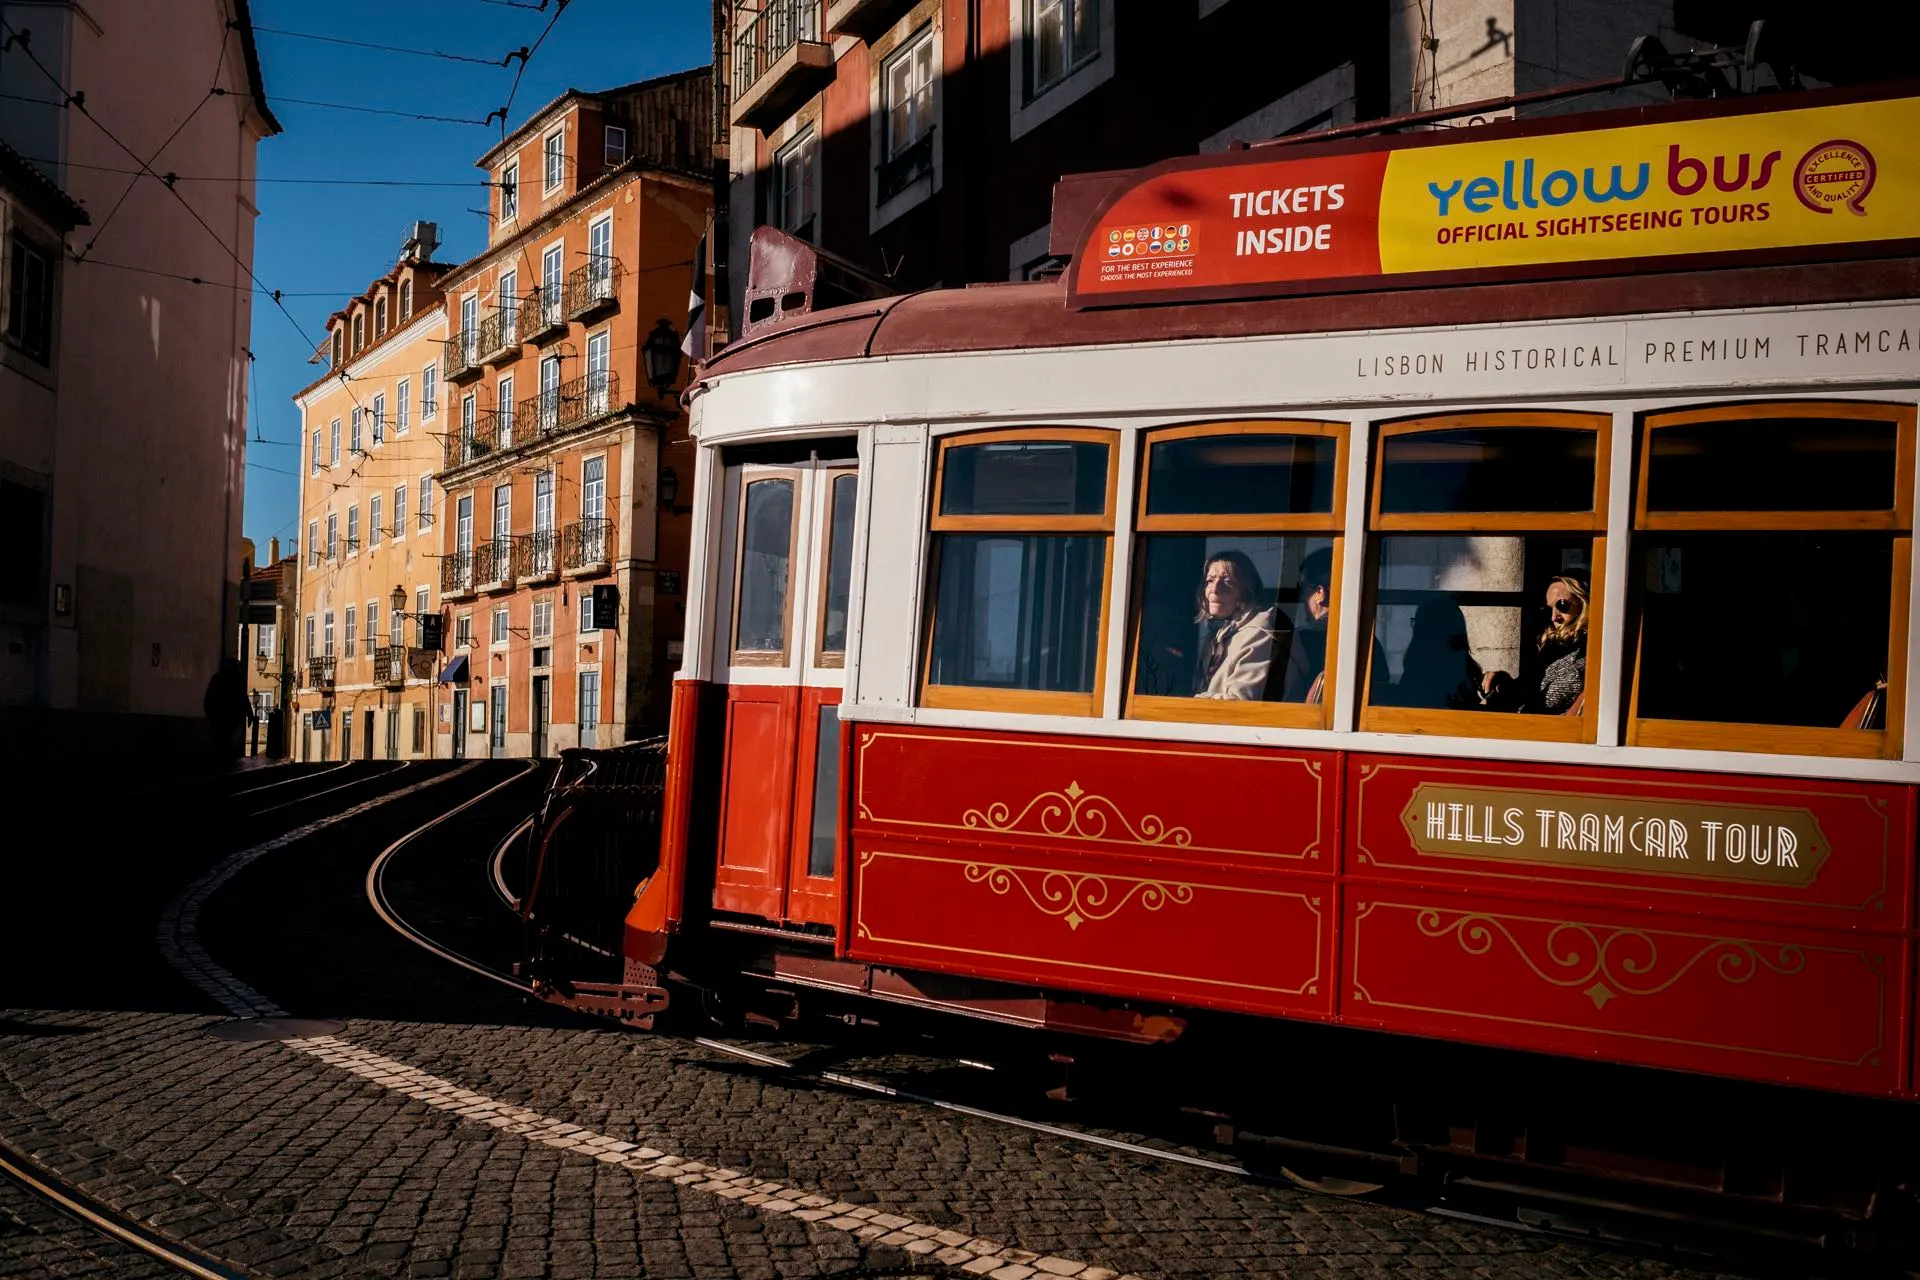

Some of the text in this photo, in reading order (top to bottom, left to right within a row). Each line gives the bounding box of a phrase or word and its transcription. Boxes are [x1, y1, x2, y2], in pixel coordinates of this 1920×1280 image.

[1667, 144, 1782, 196] bus
[1806, 171, 1863, 183] CERTIFIED
[1808, 151, 1862, 172] EXCELLENCE
[1229, 183, 1345, 218] TICKETS
[1808, 181, 1860, 202] AND QUALITY
[1437, 202, 1770, 245] OFFICIAL SIGHTSEEING TOURS
[1236, 224, 1332, 257] INSIDE
[1100, 269, 1193, 282] CHOOSE THE MOST EXPERIENCED
[1101, 259, 1193, 273] FOR THE BEST EXPERIENCE
[1357, 328, 1920, 378] LISBON HISTORICAL PREMIUM TRAMCA
[1426, 802, 1525, 846] HILLS
[1701, 820, 1799, 868] TOUR
